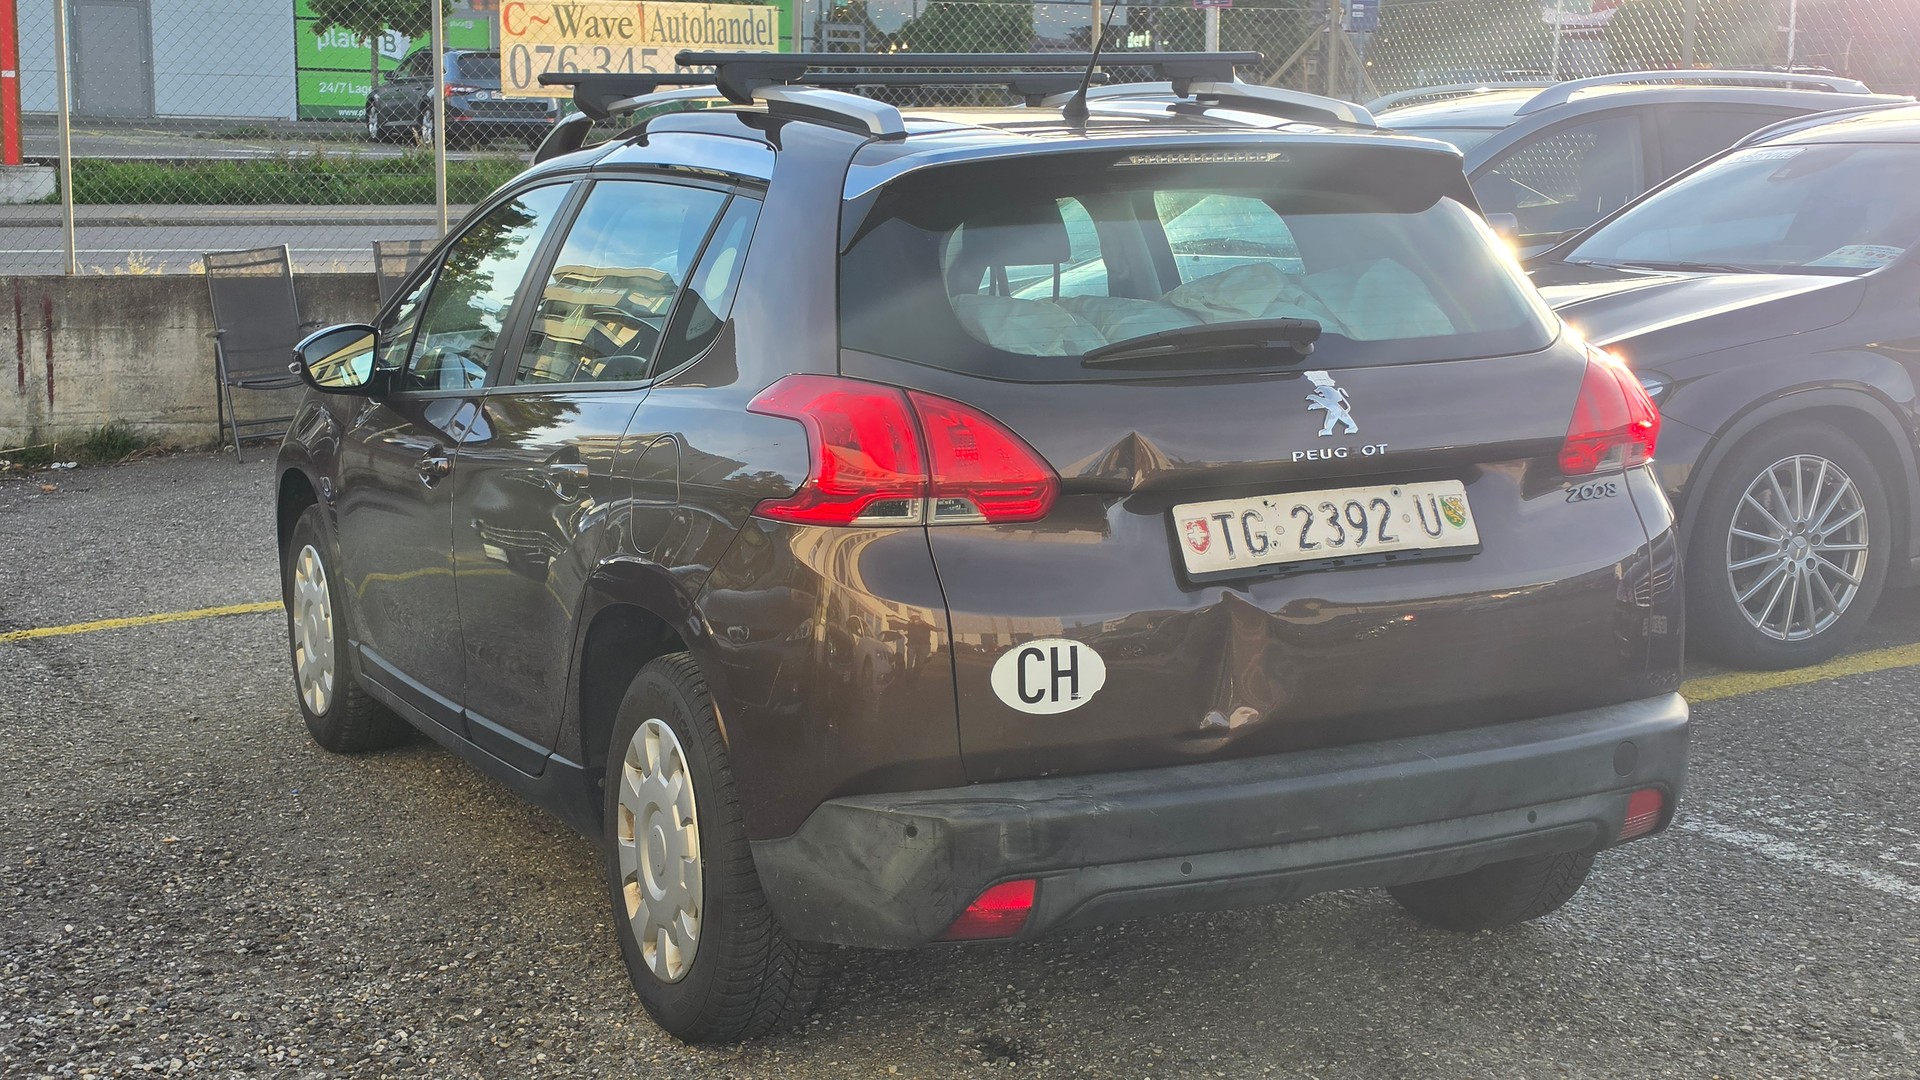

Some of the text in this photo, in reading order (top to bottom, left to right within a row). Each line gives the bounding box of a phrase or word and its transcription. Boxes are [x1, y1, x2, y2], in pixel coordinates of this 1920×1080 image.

[650, 7, 774, 46] Autohandel
[319, 82, 348, 94] 24/7
[1292, 443, 1389, 463] PEUGOT
[1565, 481, 1618, 504] 2008
[1211, 493, 1444, 560] TG 2392 U
[1017, 645, 1080, 704] CH
